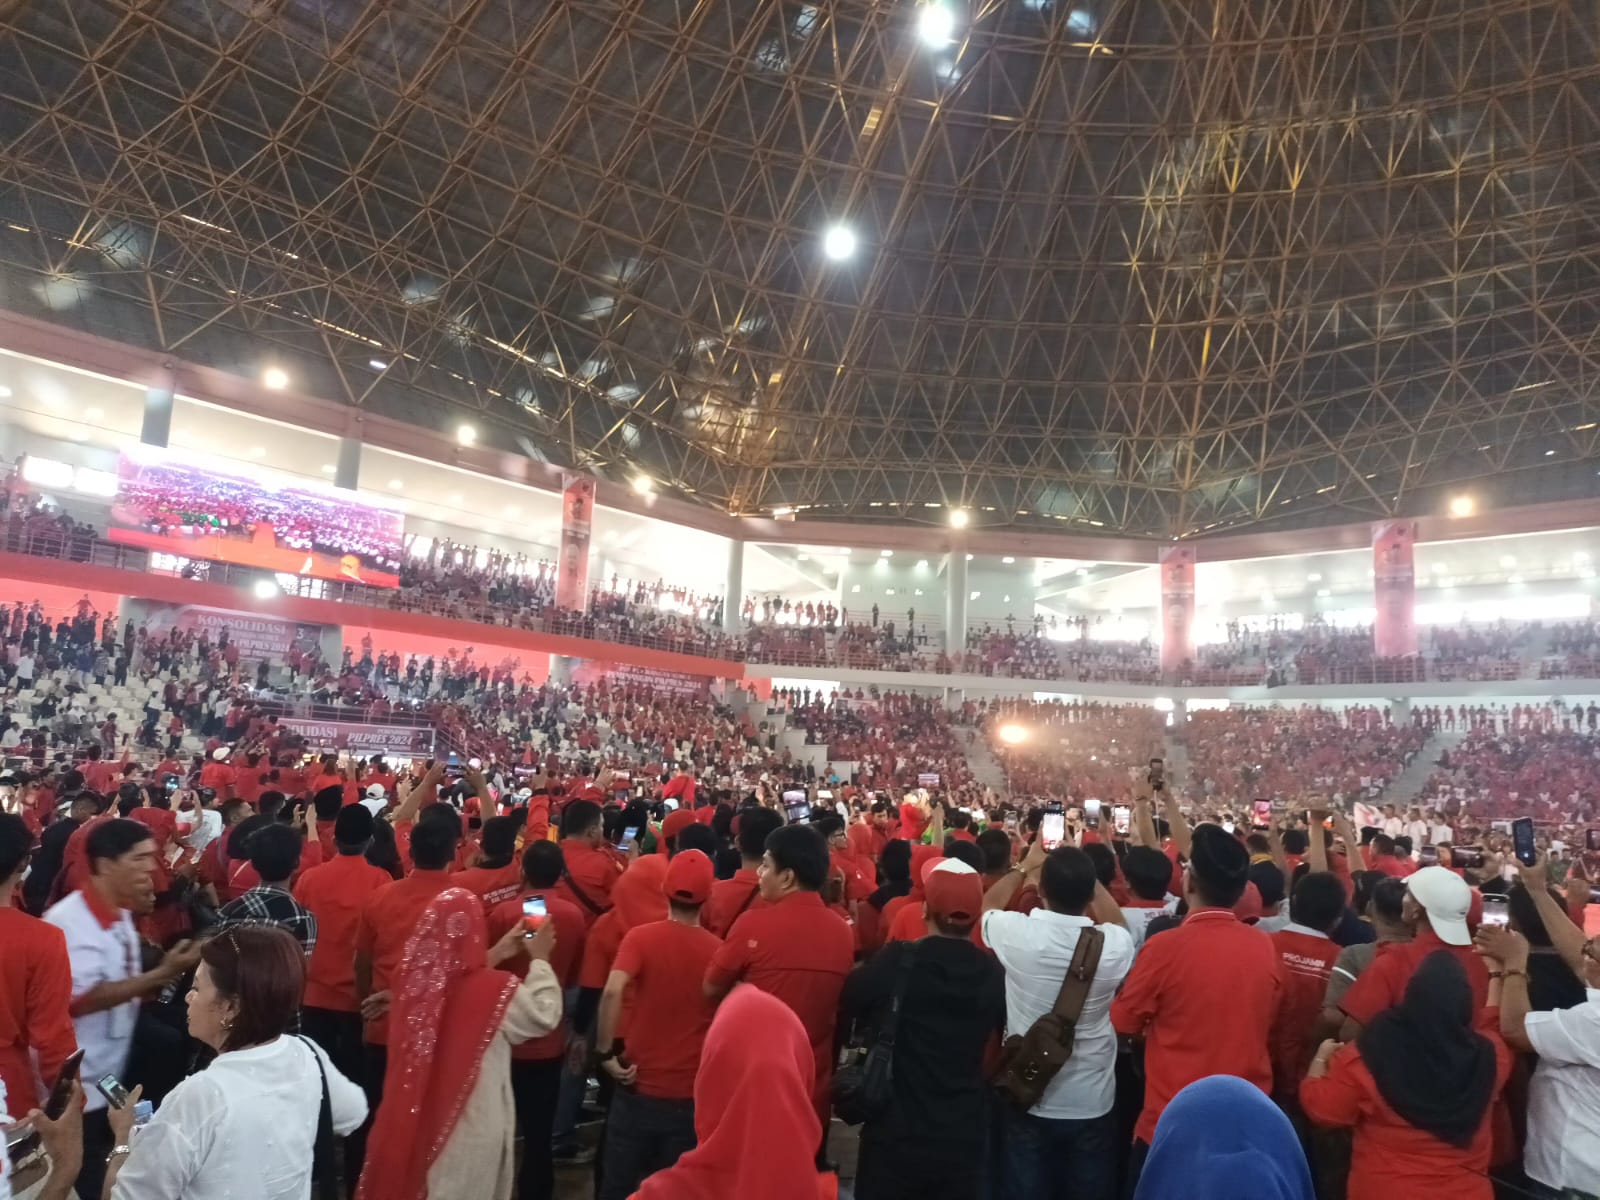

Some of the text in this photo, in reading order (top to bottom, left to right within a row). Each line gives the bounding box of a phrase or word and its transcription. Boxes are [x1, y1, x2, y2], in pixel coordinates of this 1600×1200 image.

[197, 614, 286, 635] KONSOLIDASI
[296, 628, 305, 639] 3
[347, 732, 388, 744] PILPRES
[388, 735, 413, 745] 2024
